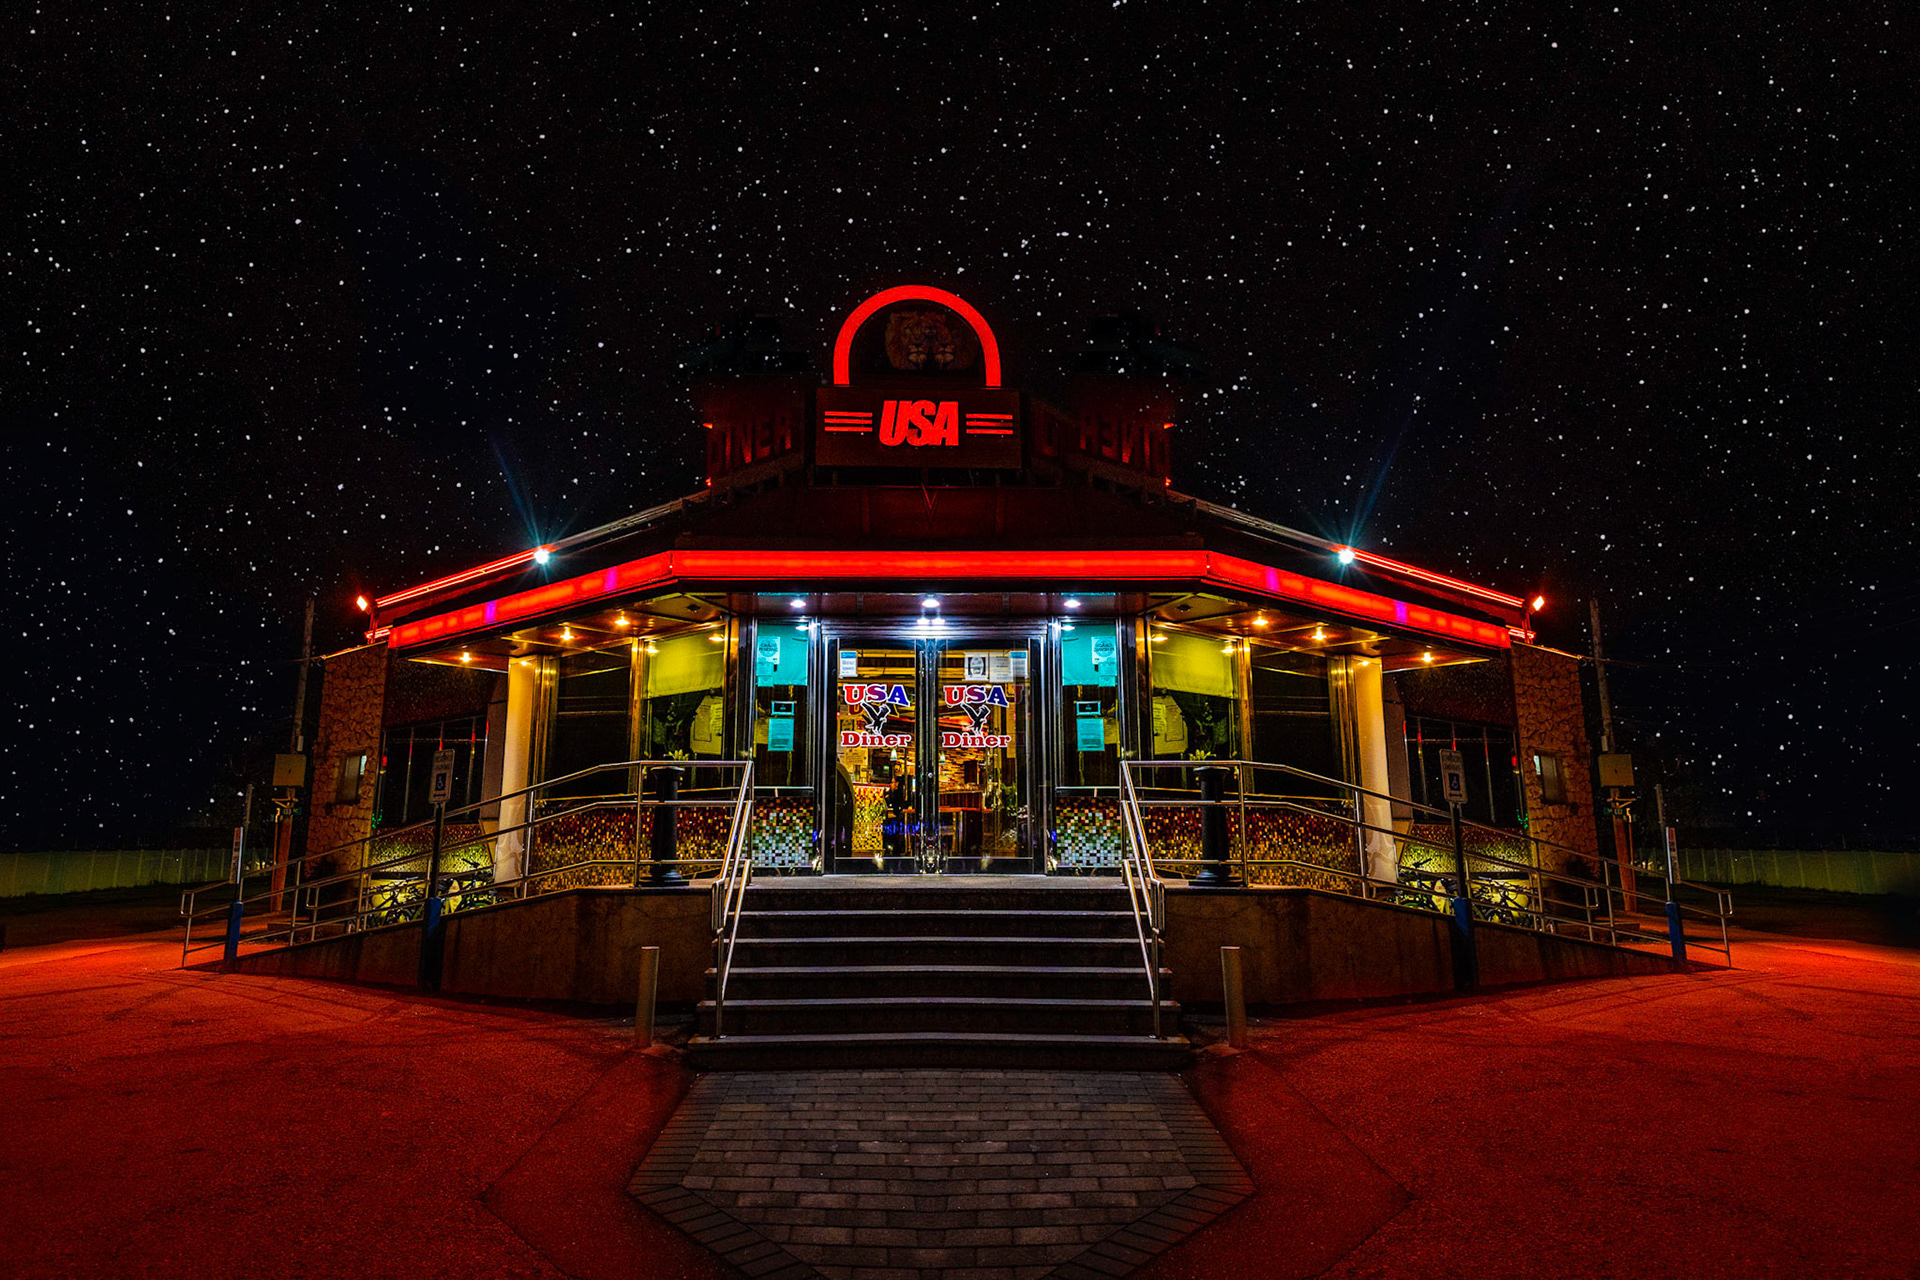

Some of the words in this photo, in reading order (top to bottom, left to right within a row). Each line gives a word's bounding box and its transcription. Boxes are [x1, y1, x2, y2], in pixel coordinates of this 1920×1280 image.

[879, 399, 959, 446] USA
[843, 684, 910, 707] USA
[943, 685, 1009, 708] USA
[841, 731, 911, 747] Diner
[942, 732, 1011, 748] Diner
